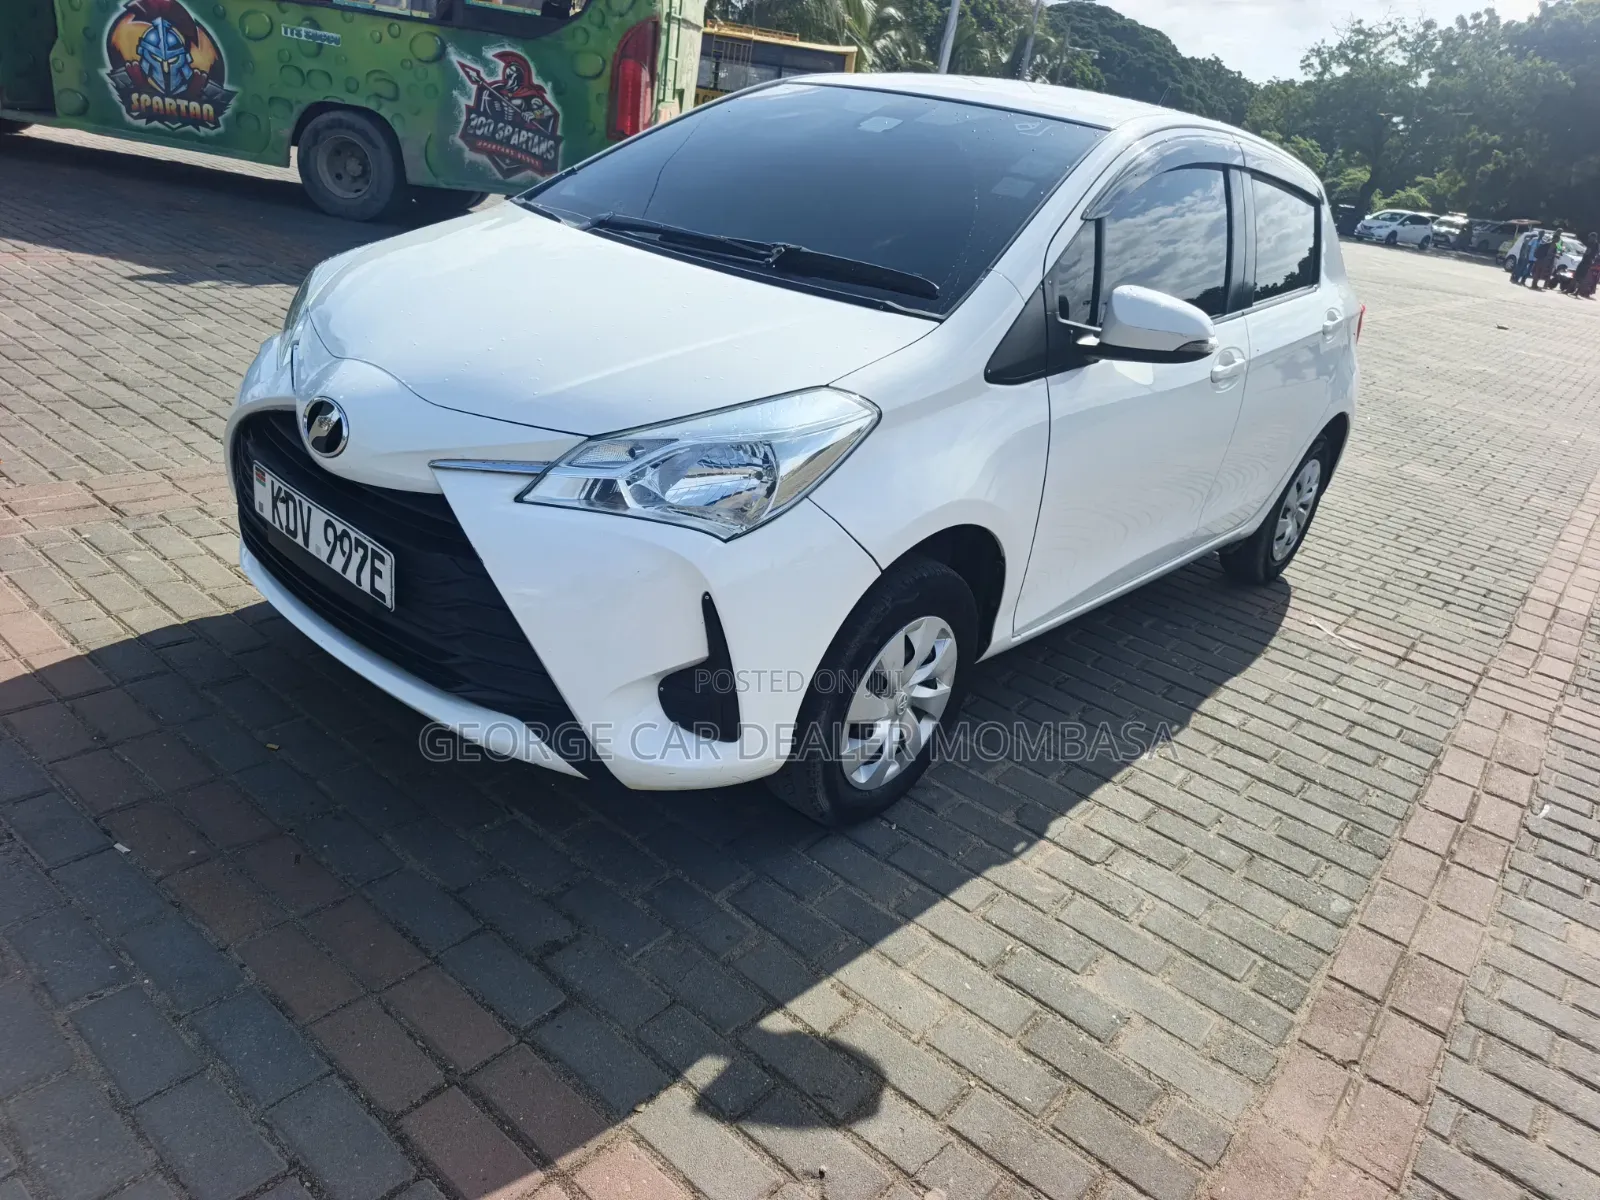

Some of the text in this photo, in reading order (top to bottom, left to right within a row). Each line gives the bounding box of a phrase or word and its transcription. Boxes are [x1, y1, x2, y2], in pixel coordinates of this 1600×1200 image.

[131, 92, 215, 121] SPARTAN
[495, 122, 556, 161] SPARTANS
[271, 480, 387, 604] KDV 997E
